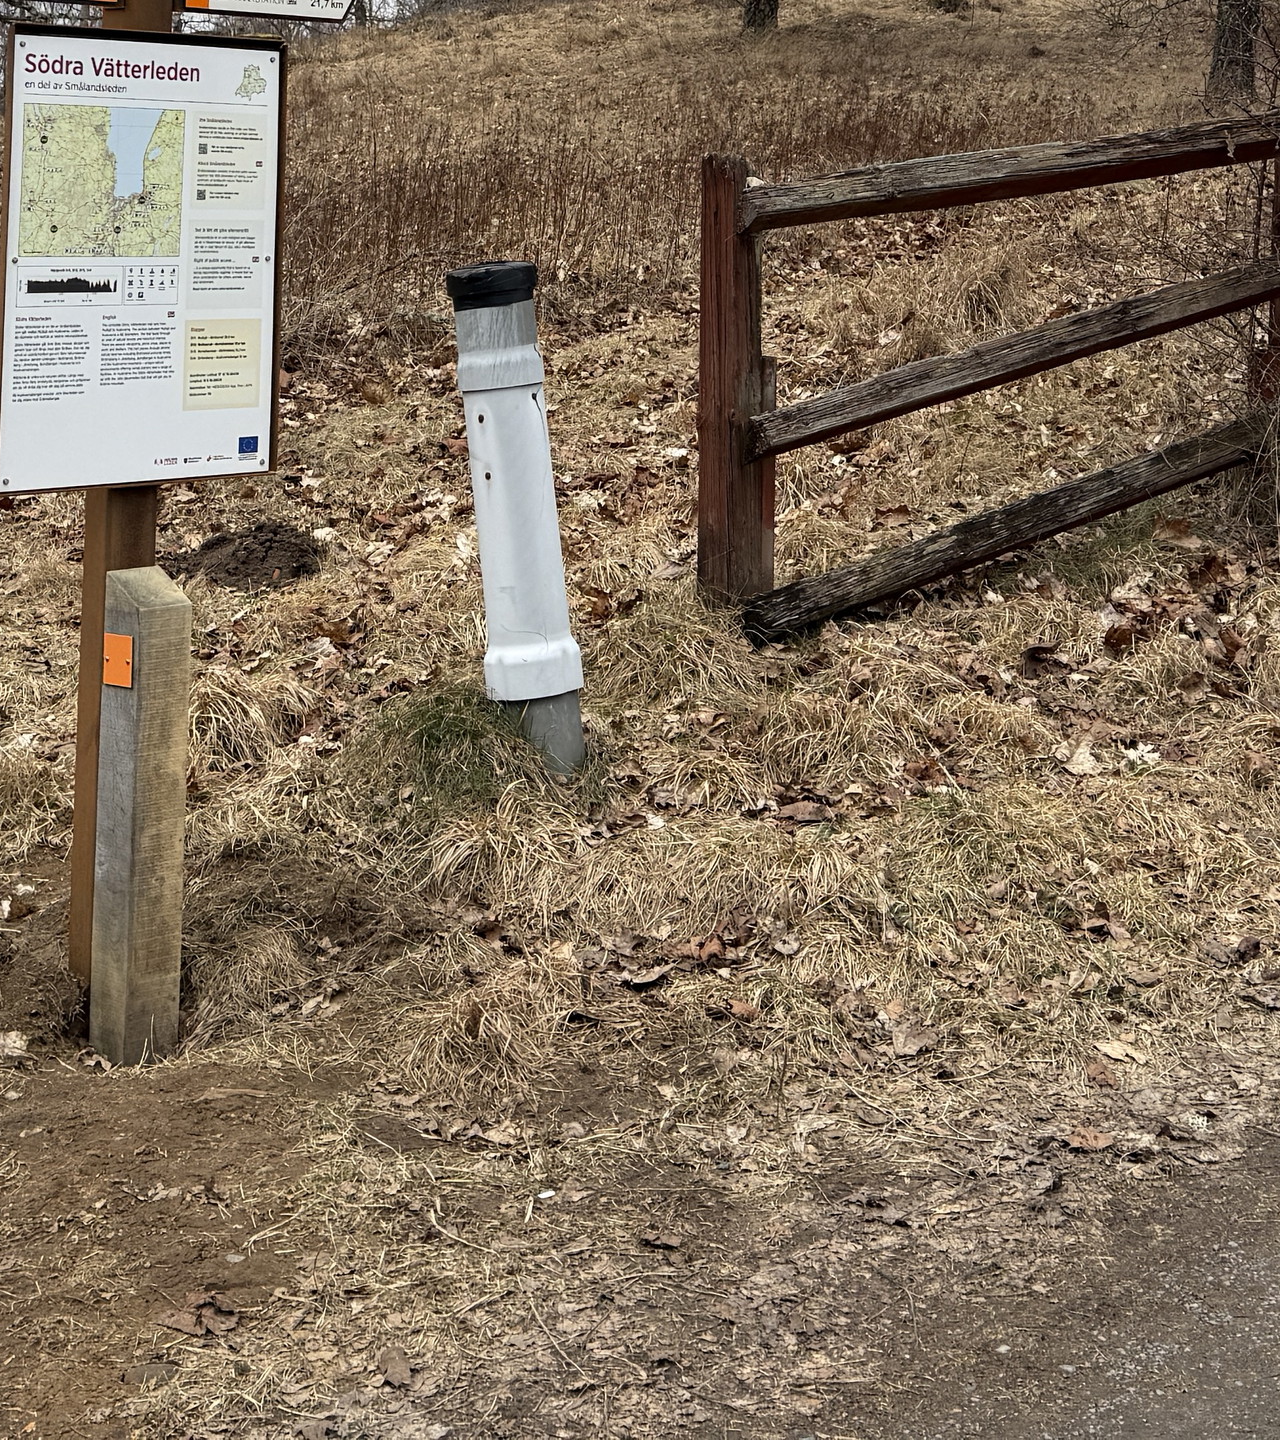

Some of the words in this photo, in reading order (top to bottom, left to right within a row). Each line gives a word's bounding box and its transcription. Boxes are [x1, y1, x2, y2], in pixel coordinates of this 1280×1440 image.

[330, 0, 344, 9] km
[24, 53, 84, 76] Södra
[91, 57, 200, 82] Vätterleden
[24, 81, 36, 89] en
[38, 80, 51, 89] del
[65, 81, 127, 93] Smålandsleden
